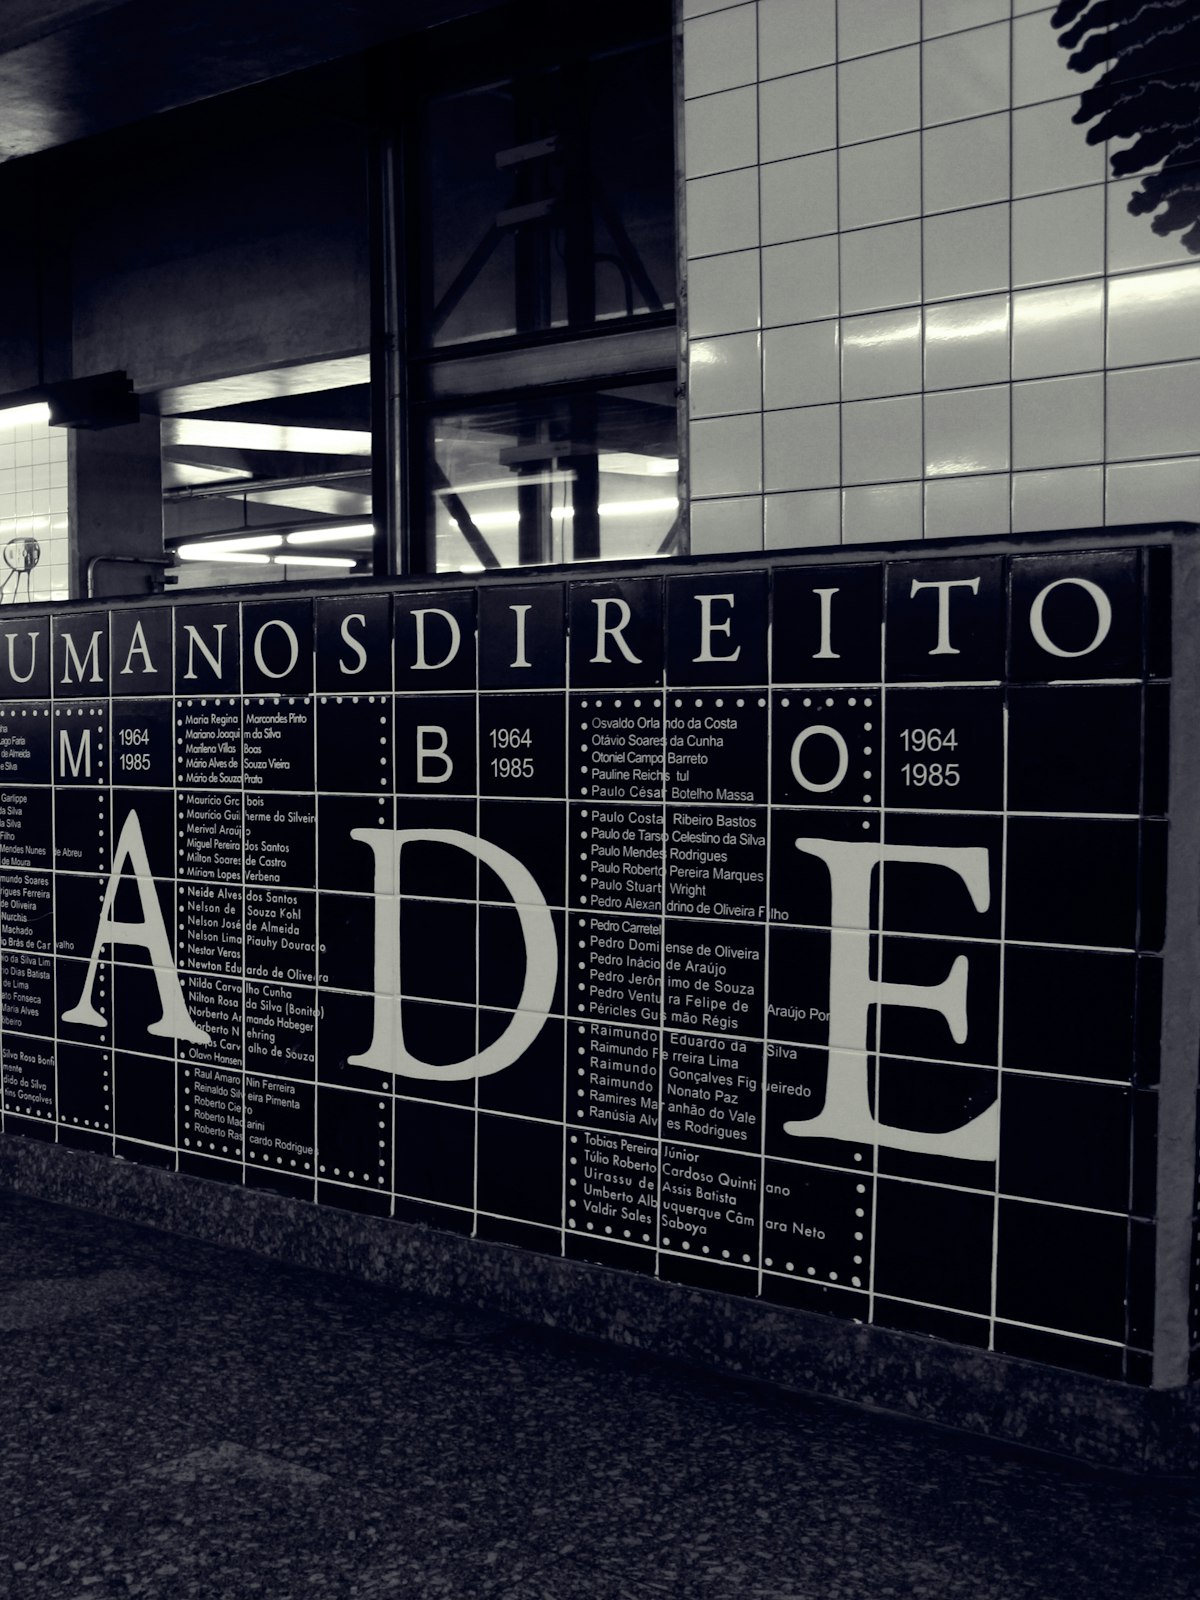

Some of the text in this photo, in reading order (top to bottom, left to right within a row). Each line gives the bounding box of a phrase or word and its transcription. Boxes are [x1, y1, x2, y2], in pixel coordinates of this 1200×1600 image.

[592, 718, 634, 729] Osvaldo
[688, 718, 701, 729] da
[704, 718, 737, 729] Costa
[119, 729, 149, 745] 1964
[490, 729, 532, 749] 1964
[592, 734, 723, 747] Otávio Soares da Cunha
[900, 728, 958, 752] 1964
[120, 754, 150, 770] 1985
[186, 758, 290, 769] Mário Alves de Souza Vieira
[491, 758, 534, 778] 1985
[592, 752, 708, 766] Otoniel Campo Barreto
[592, 769, 630, 780] Pauline
[900, 763, 960, 787] 1985
[592, 786, 753, 800] Paulo César Botelho Massa
[592, 811, 756, 827] Paulo Costa Ribeiro Bastos
[591, 828, 765, 846] Paulo de Tarso Celestino da Silva
[187, 853, 286, 867] Milton Soares de Castro
[591, 845, 727, 863] Paulo Mendes Rodrigues
[24, 875, 49, 886] Soares
[591, 862, 764, 883] Paulo Roberto Pereira Marques
[188, 887, 297, 904] Neide Alves dos Santos
[591, 879, 706, 897] Paulo Stuart Wright
[188, 901, 300, 919] Nelson de Souza Kohl
[188, 916, 300, 934] Nelson José de Almeida
[590, 919, 661, 935] Pedro Carretel
[188, 944, 241, 958] Nestor Veras
[590, 953, 726, 976] Pedro Inácio de Araújo
[189, 978, 212, 989] Nilda
[263, 986, 292, 999] Cunha
[590, 969, 624, 983] Pedro
[694, 976, 709, 990] de
[714, 981, 754, 995] Souza
[590, 1002, 636, 1018] Péricles
[703, 1014, 738, 1030] Régis
[591, 1024, 797, 1059] Raimundo Eduardo da Silva
[590, 1041, 648, 1058] Raimundo
[709, 1054, 739, 1069] Lima
[194, 1068, 295, 1094] Raul Amaro Nin Ferreira
[590, 1057, 657, 1076] Raimundo
[669, 1067, 733, 1086] Gonçalves
[590, 1073, 738, 1104] Raimundo Nonato Paz
[590, 1090, 636, 1106] Ramires
[709, 1106, 725, 1119] do
[729, 1110, 756, 1124] Vale
[589, 1106, 635, 1123] Ranúsia
[685, 1120, 747, 1140] Rodrigues
[584, 1133, 699, 1163] Tobias Pereira Júnior
[584, 1167, 736, 1205] Uirassu de Assis Batista
[583, 1200, 707, 1235] Valdir Sales Saboya
[584, 1183, 633, 1203] Umberto
[793, 1222, 825, 1239] Neto
